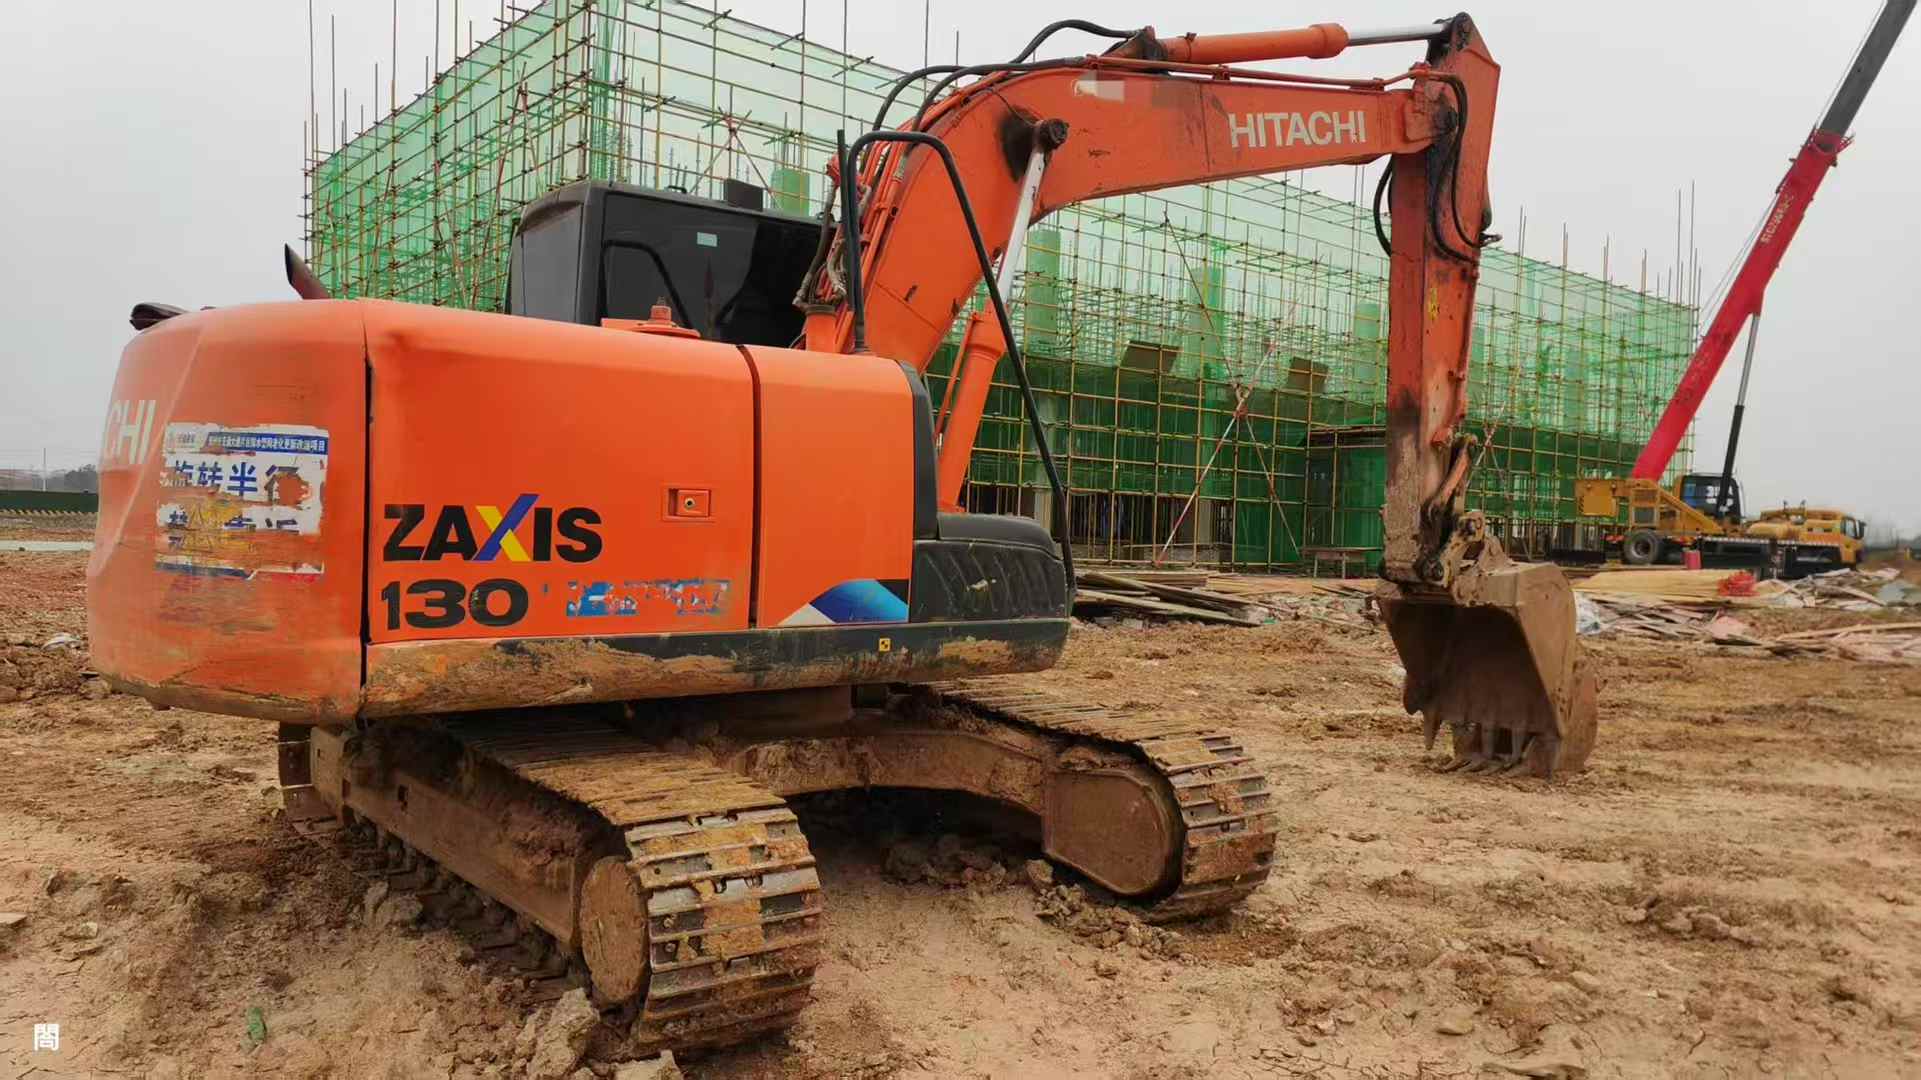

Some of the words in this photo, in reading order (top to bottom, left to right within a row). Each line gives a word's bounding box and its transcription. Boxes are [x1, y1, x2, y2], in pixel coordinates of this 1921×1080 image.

[1228, 110, 1367, 149] HITACHI
[383, 493, 603, 563] ZAXIS
[380, 578, 529, 631] 130
